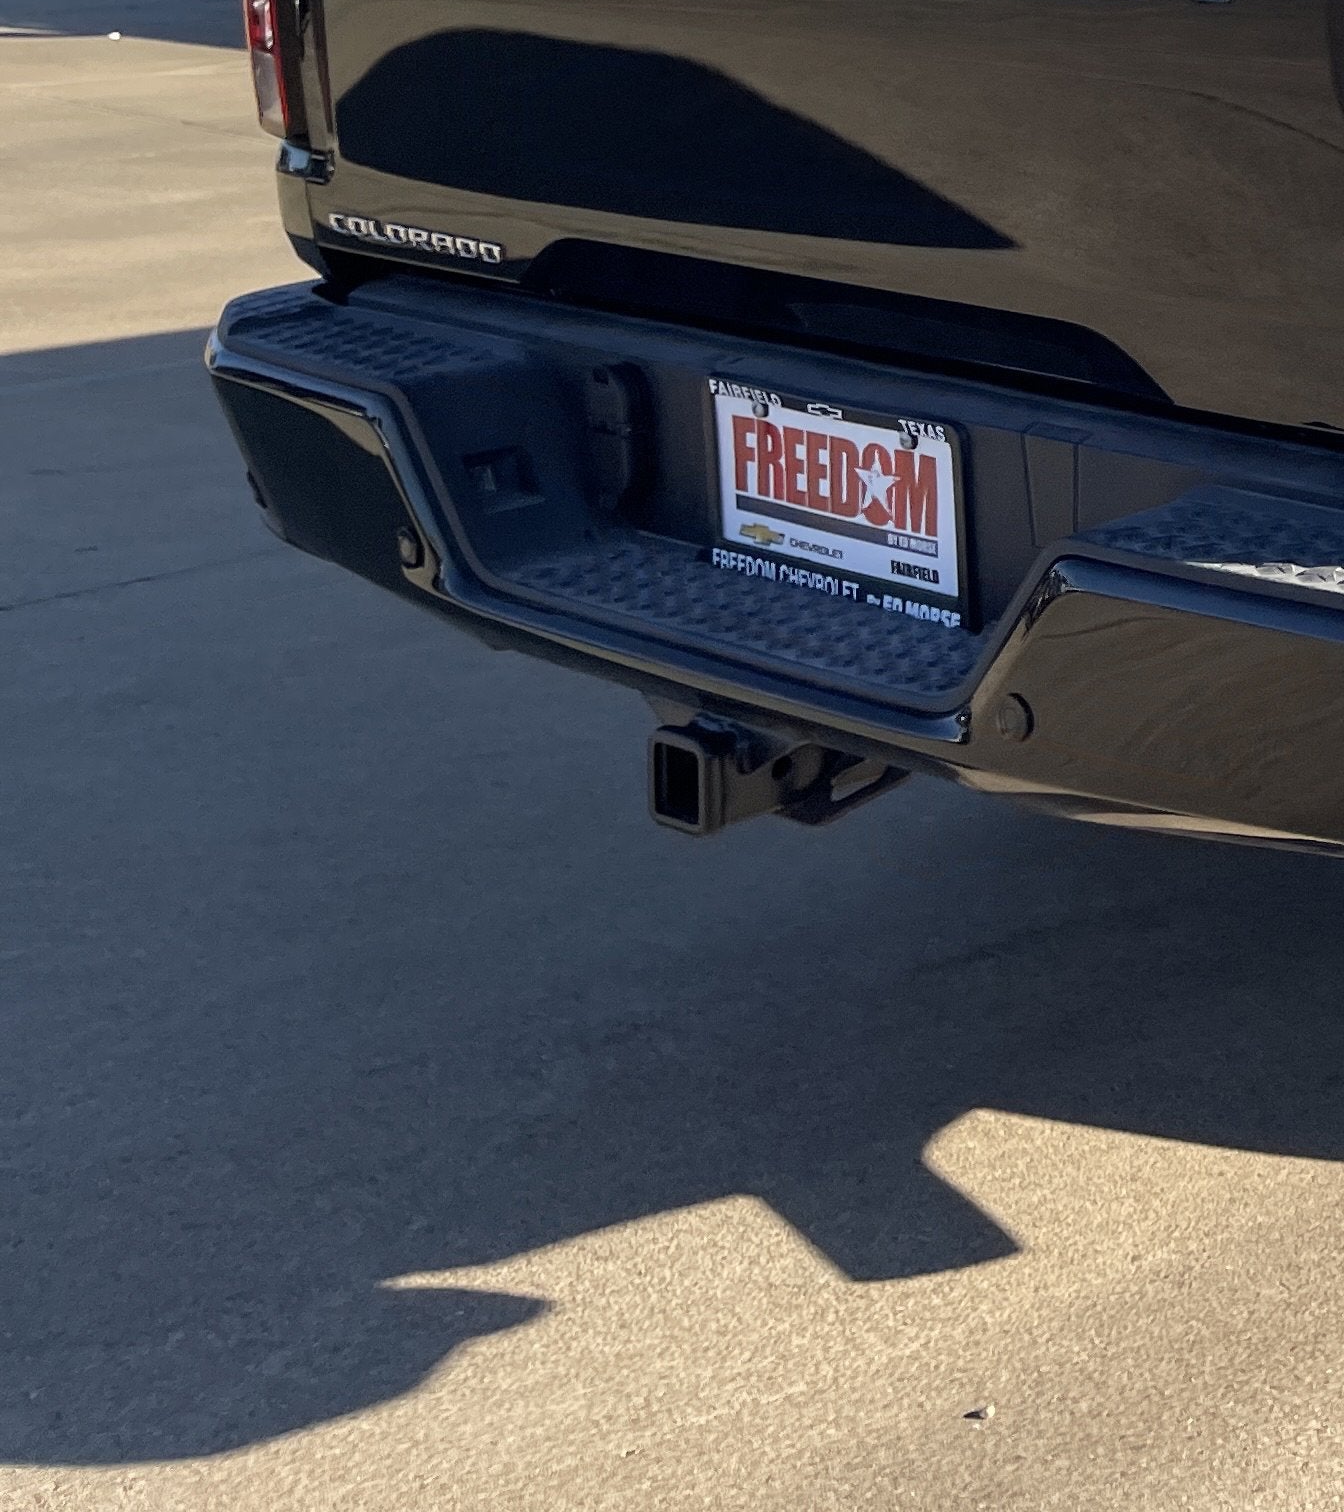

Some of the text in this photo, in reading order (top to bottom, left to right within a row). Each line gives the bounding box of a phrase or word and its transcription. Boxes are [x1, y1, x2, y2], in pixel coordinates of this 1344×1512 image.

[328, 212, 504, 264] COLORADO
[708, 378, 947, 441] FAIRFIELD TEXAS
[731, 414, 938, 538] FREEDOM
[712, 547, 777, 582] FREEDOM
[778, 564, 860, 602] CHEVROLET
[890, 559, 940, 585] FAIRFIELD
